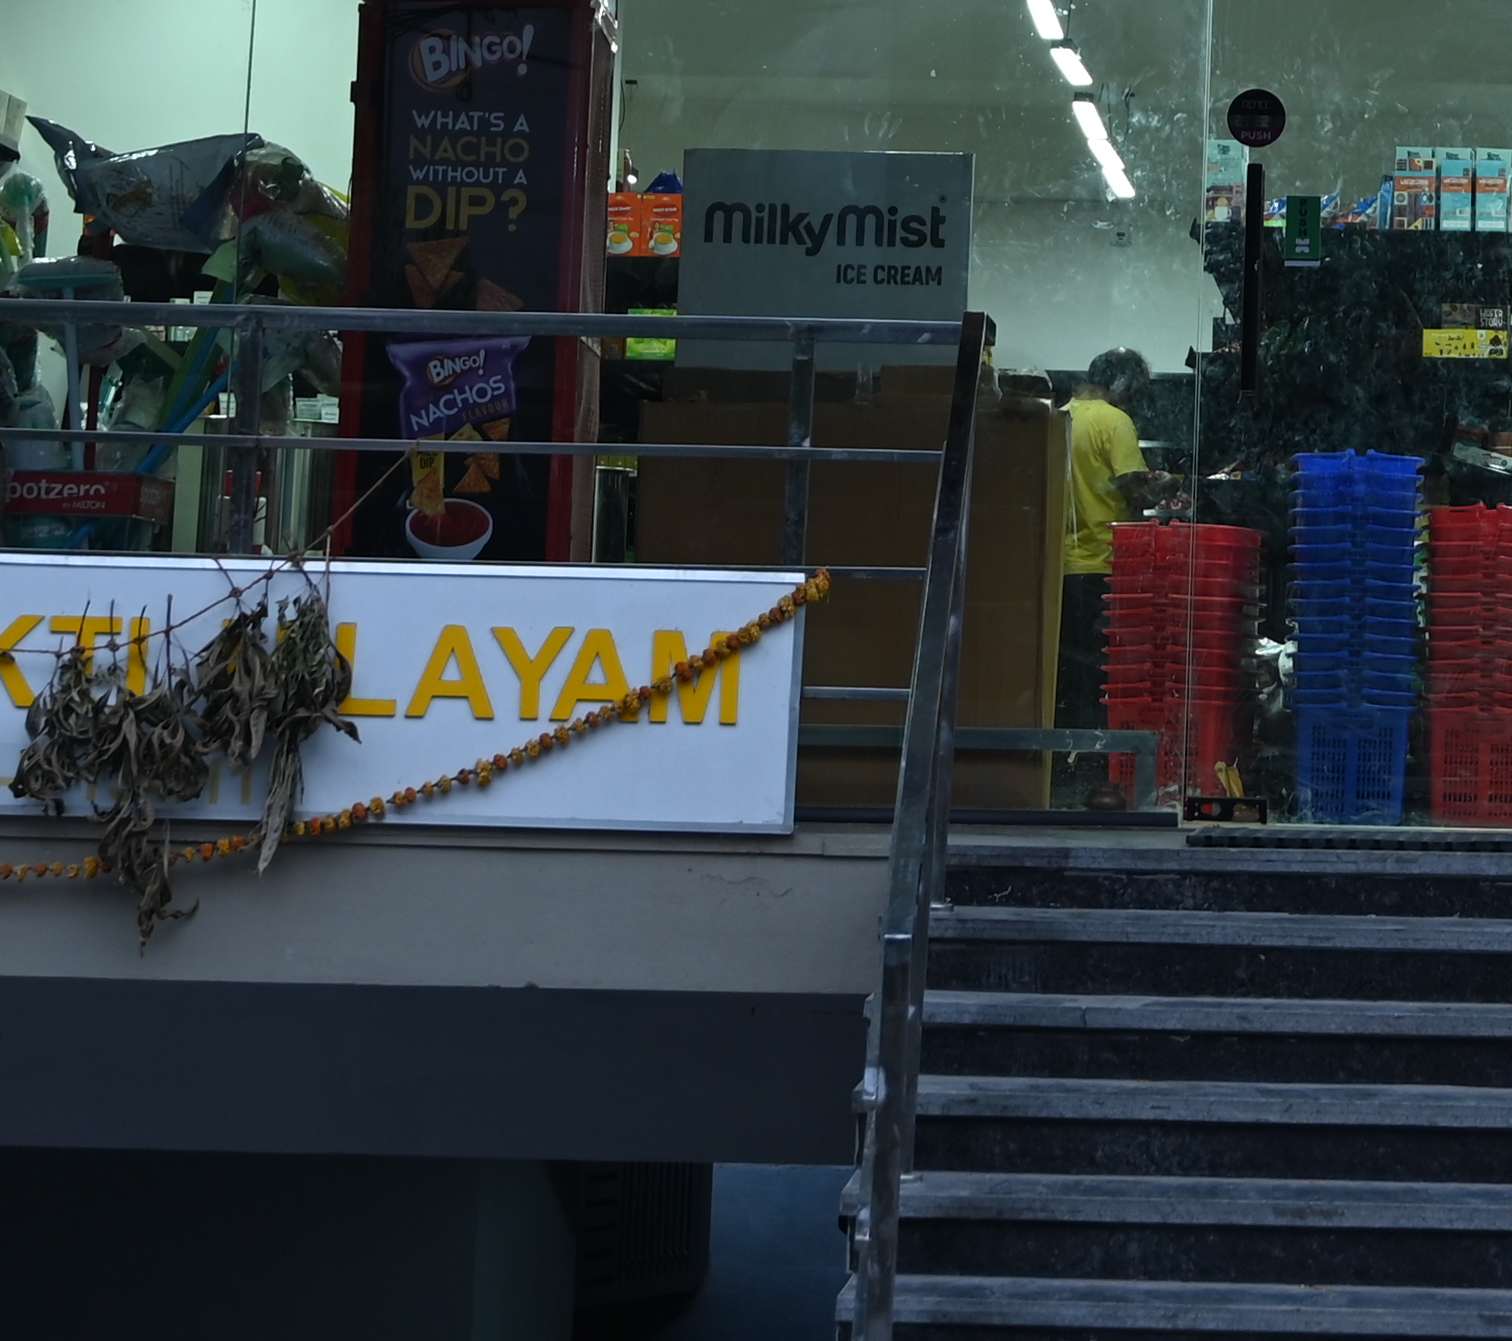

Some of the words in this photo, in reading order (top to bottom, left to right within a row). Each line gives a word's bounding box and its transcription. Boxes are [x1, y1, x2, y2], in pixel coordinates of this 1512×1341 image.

[419, 23, 535, 82] BINGO!
[411, 109, 506, 132] WHAT'S
[513, 113, 530, 133] A
[1240, 130, 1272, 140] PUSH
[408, 134, 530, 163] NACHO
[408, 164, 508, 184] WITHOUT
[513, 168, 528, 185] A
[405, 184, 528, 232] DIP?
[703, 201, 948, 257] MilkyMist
[835, 263, 868, 286] ICE
[872, 263, 943, 287] CREAM
[428, 348, 487, 384] BINGO!
[409, 374, 507, 432] NACHOS
[222, 617, 741, 726] LAYAM
